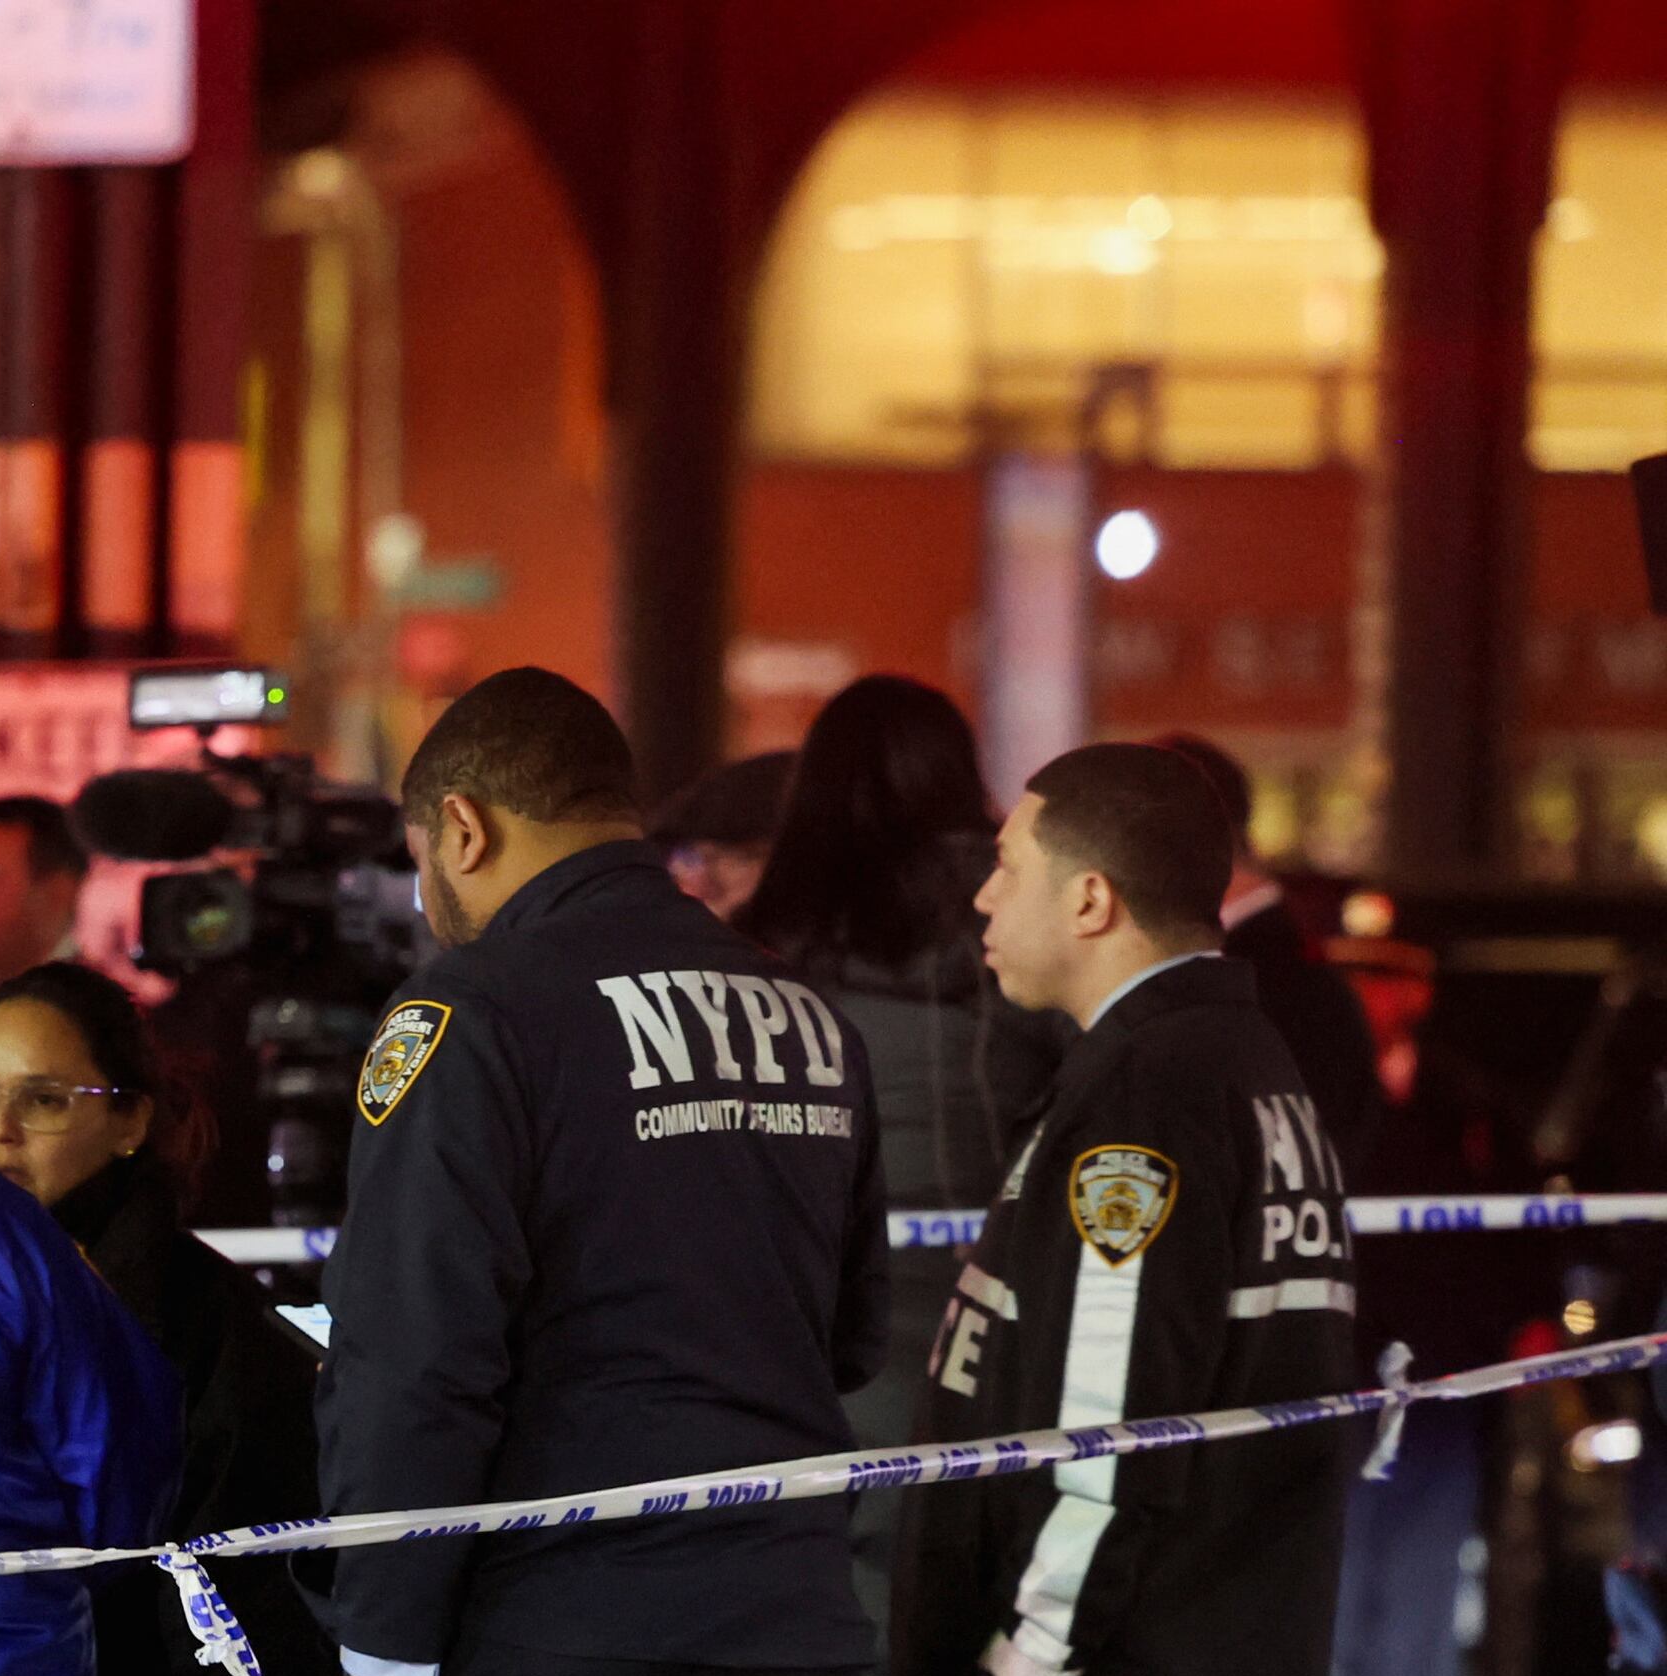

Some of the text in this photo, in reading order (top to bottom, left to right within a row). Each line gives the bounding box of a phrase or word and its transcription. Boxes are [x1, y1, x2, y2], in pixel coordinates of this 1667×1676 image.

[596, 970, 845, 1090] NYPD
[635, 1099, 745, 1141] COMMUNITY
[1252, 1093, 1344, 1194] NY
